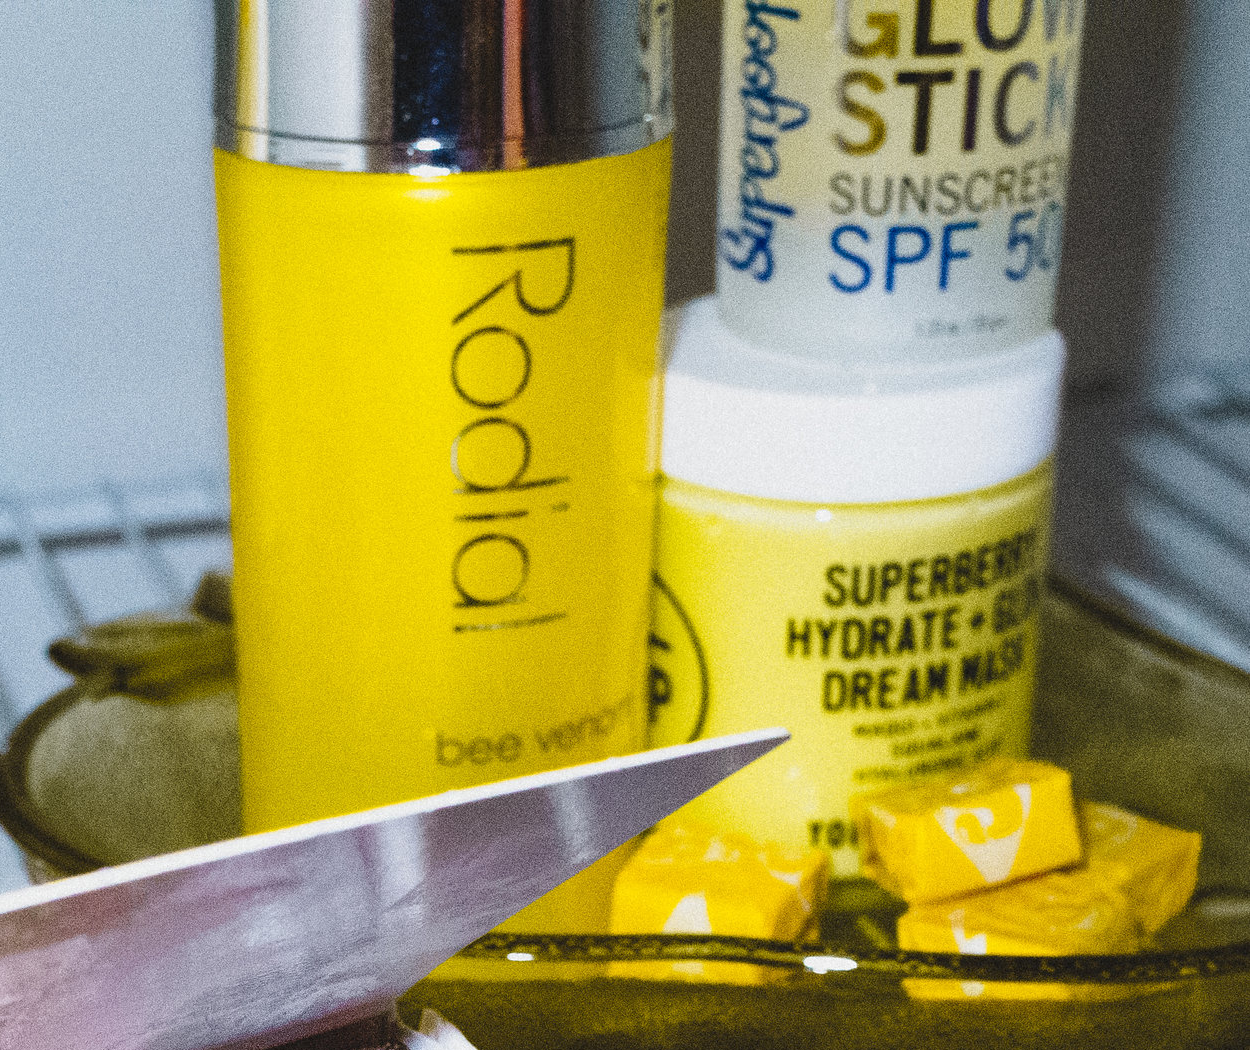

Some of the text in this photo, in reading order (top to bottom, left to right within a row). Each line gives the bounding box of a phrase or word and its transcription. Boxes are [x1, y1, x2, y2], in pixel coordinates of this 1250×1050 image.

[828, 155, 1066, 219] SUNSCREE
[828, 220, 980, 294] SPF
[449, 236, 577, 634] Rodial
[786, 607, 960, 661] HYDRATE
[821, 661, 951, 715] DREAM
[435, 730, 524, 768] bee
